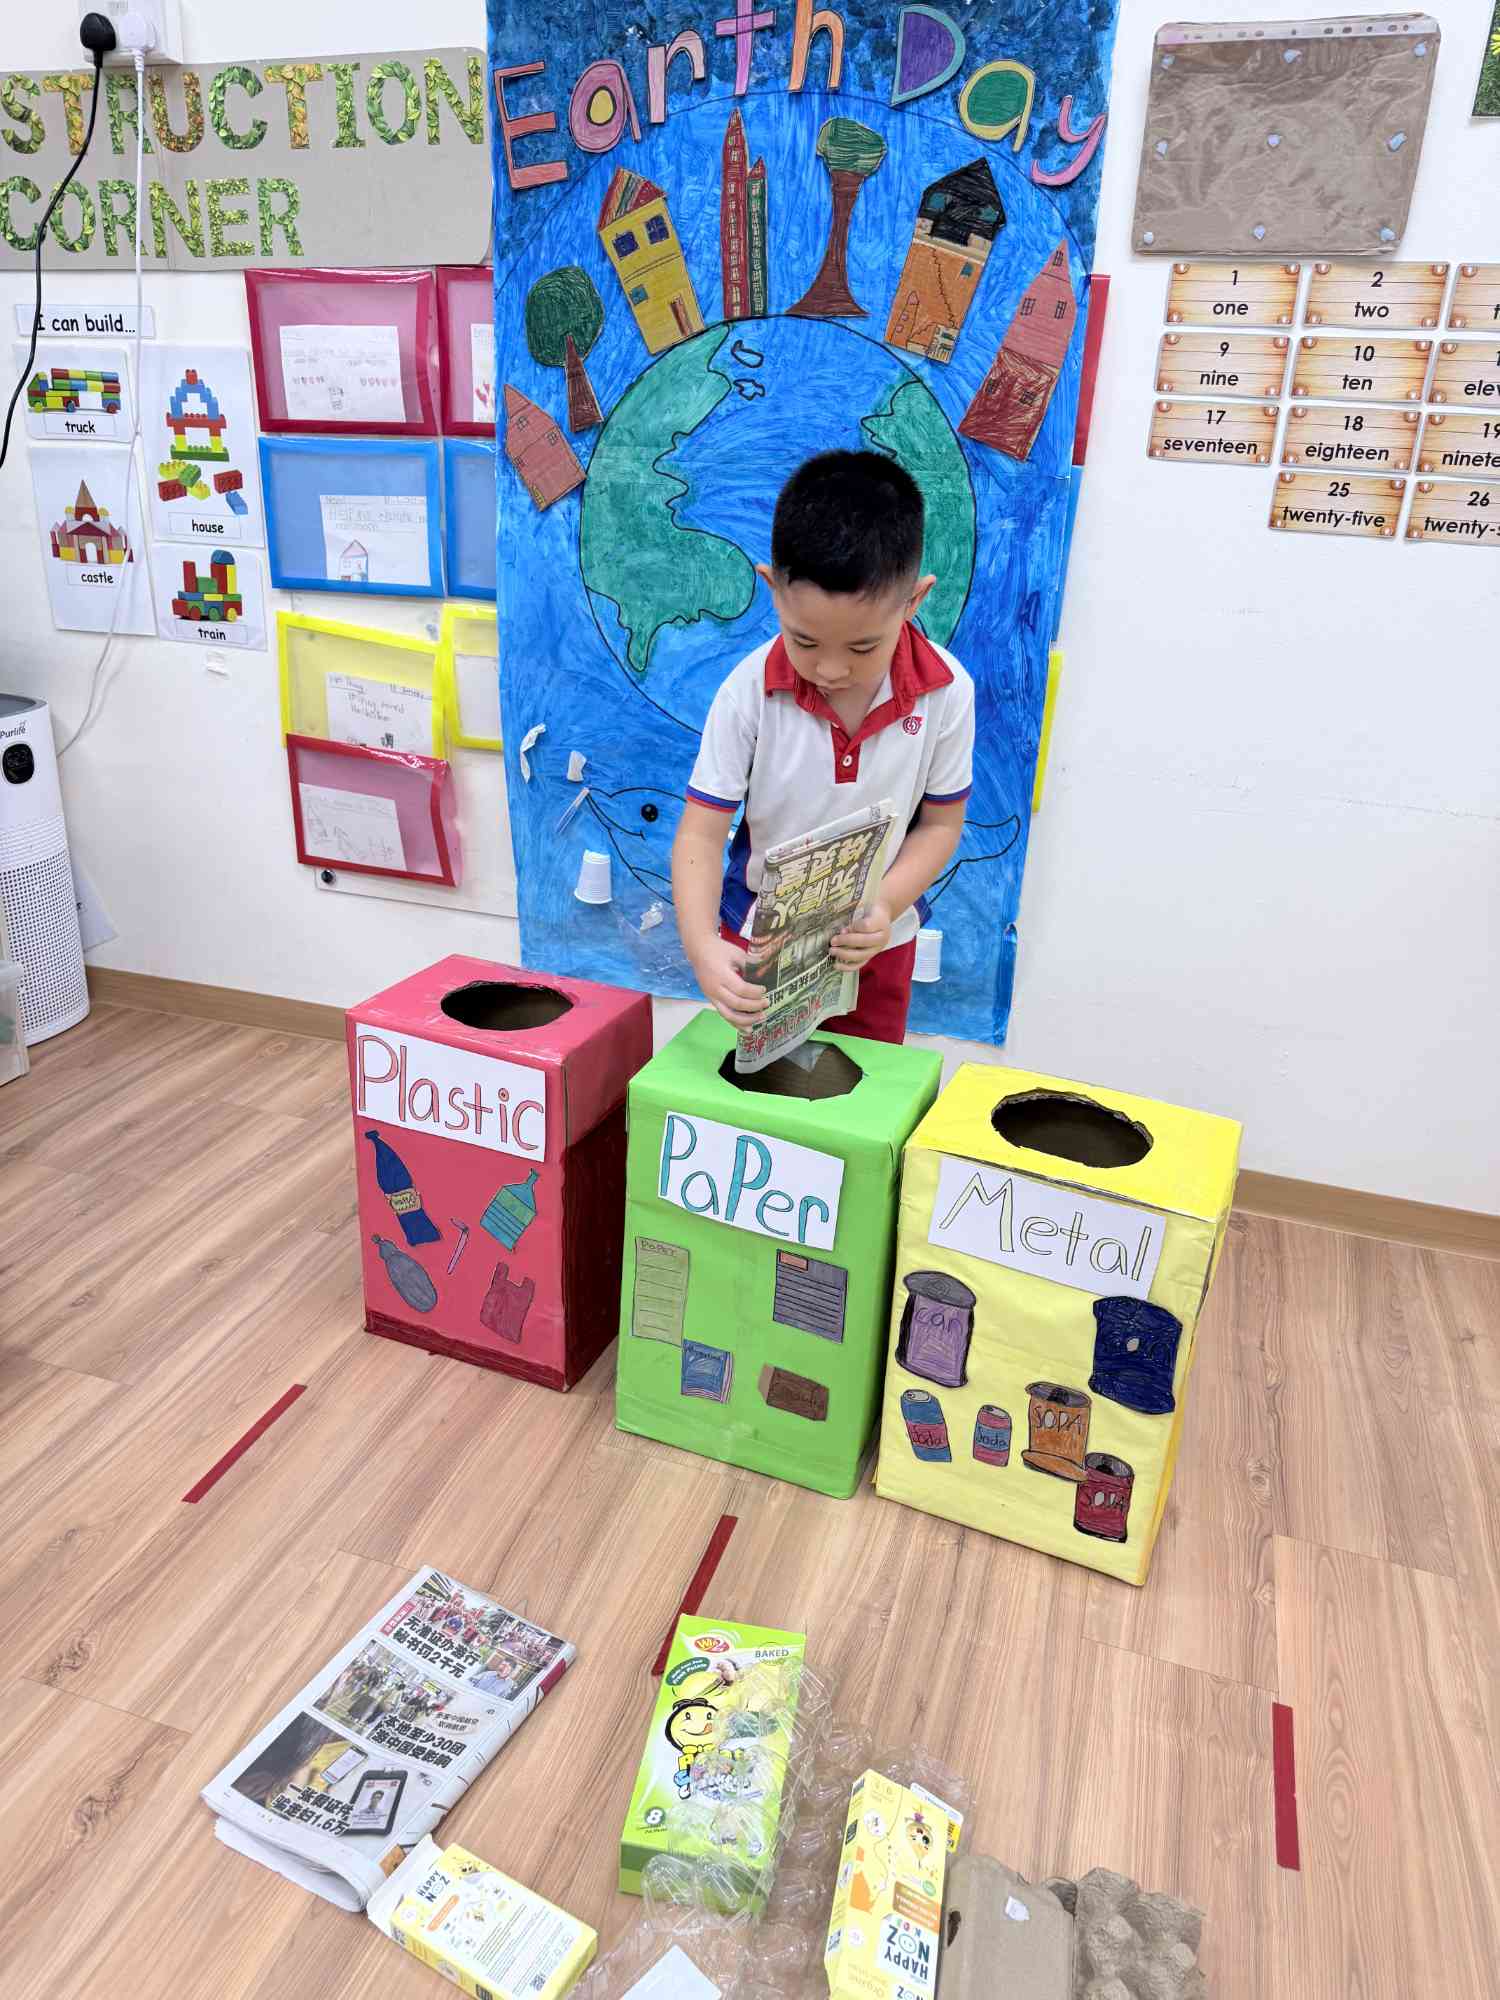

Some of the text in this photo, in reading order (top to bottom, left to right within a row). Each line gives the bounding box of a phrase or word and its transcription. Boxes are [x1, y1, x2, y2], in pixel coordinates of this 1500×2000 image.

[494, 0, 1107, 190] Earth Day
[0, 57, 484, 156] STRUCTION
[0, 176, 304, 258] CORNER
[1231, 270, 1238, 286] 1
[1371, 272, 1383, 287] 2
[1213, 302, 1248, 315] one
[1354, 303, 1389, 318] two
[52, 318, 81, 332] can
[85, 313, 136, 334] build...
[1219, 342, 1229, 357] 9
[1354, 345, 1375, 362] 10
[1200, 371, 1239, 387] nine
[1342, 375, 1373, 391] ten
[1206, 410, 1226, 425] 17
[1343, 416, 1364, 431] 18
[65, 420, 96, 434] truck
[1163, 438, 1258, 455] seventeen
[1305, 442, 1389, 462] eighteen
[1328, 483, 1350, 498] 25
[1467, 492, 1490, 507] 26
[1282, 506, 1386, 529] twenty-five
[191, 519, 224, 534] house
[81, 571, 114, 584] castle
[198, 626, 227, 641] train
[358, 1035, 544, 1150] Plastic
[938, 1172, 1152, 1282] Metal
[754, 1649, 789, 1658] BAKED
[384, 1714, 467, 1756] 本地至少30团
[371, 1729, 453, 1768] 游中国受影响
[646, 1809, 662, 1824] 8
[416, 1869, 441, 1897] HAPPY
[884, 1945, 929, 1980] HAPPY
